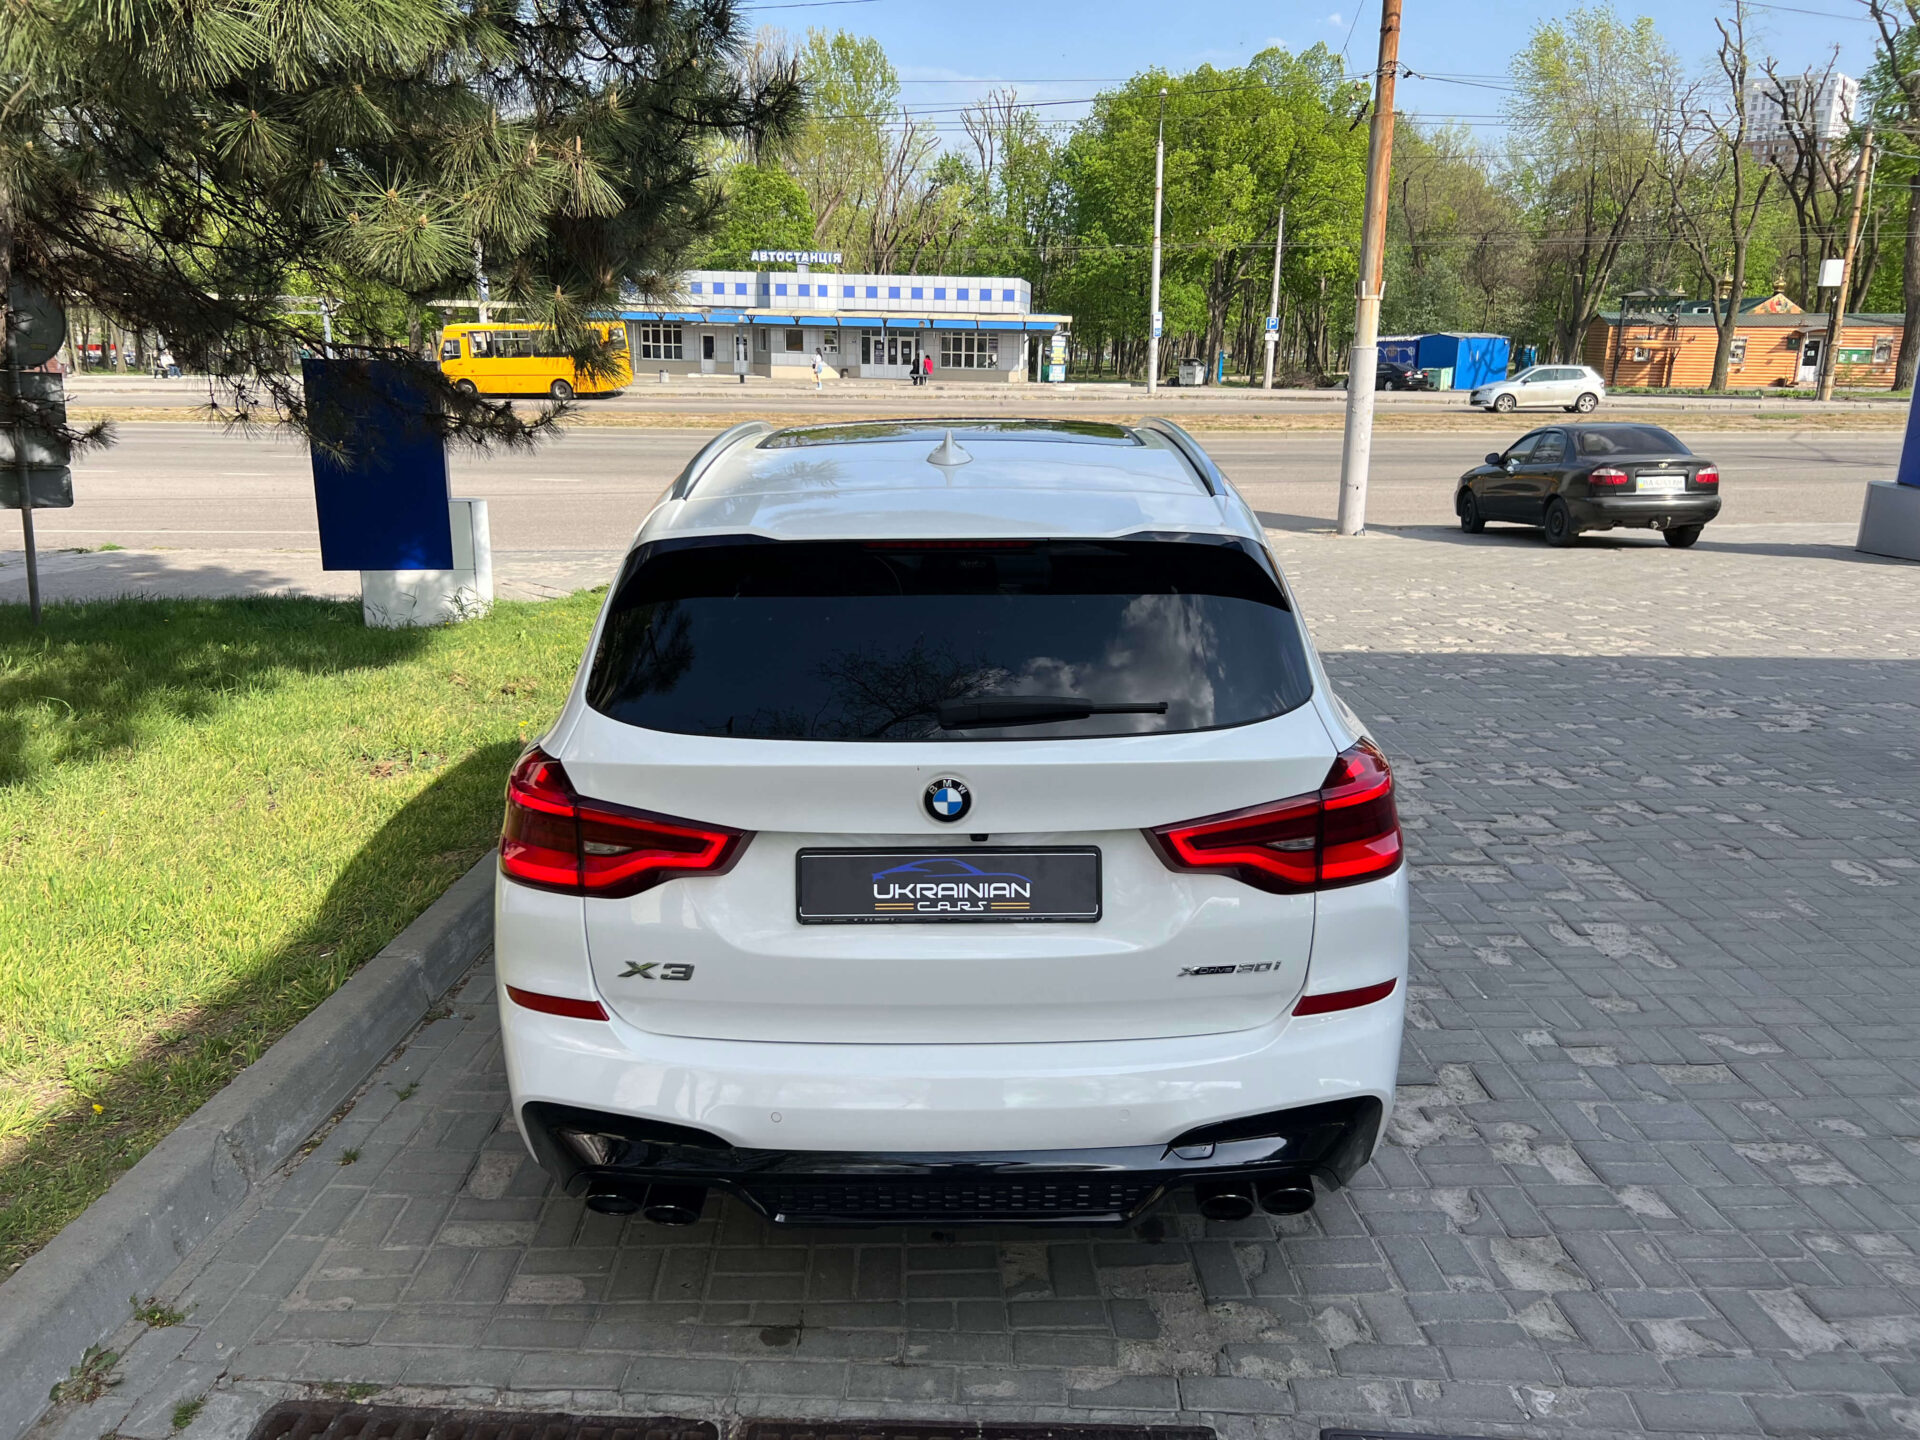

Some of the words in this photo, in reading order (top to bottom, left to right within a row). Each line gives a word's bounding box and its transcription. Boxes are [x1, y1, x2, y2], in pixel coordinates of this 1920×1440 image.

[751, 250, 842, 264] АВТОСТАНЦІЯ
[929, 779, 967, 795] BMW
[873, 883, 1030, 899] UKRAINIAN
[917, 901, 987, 911] CARS
[617, 960, 695, 981] X3
